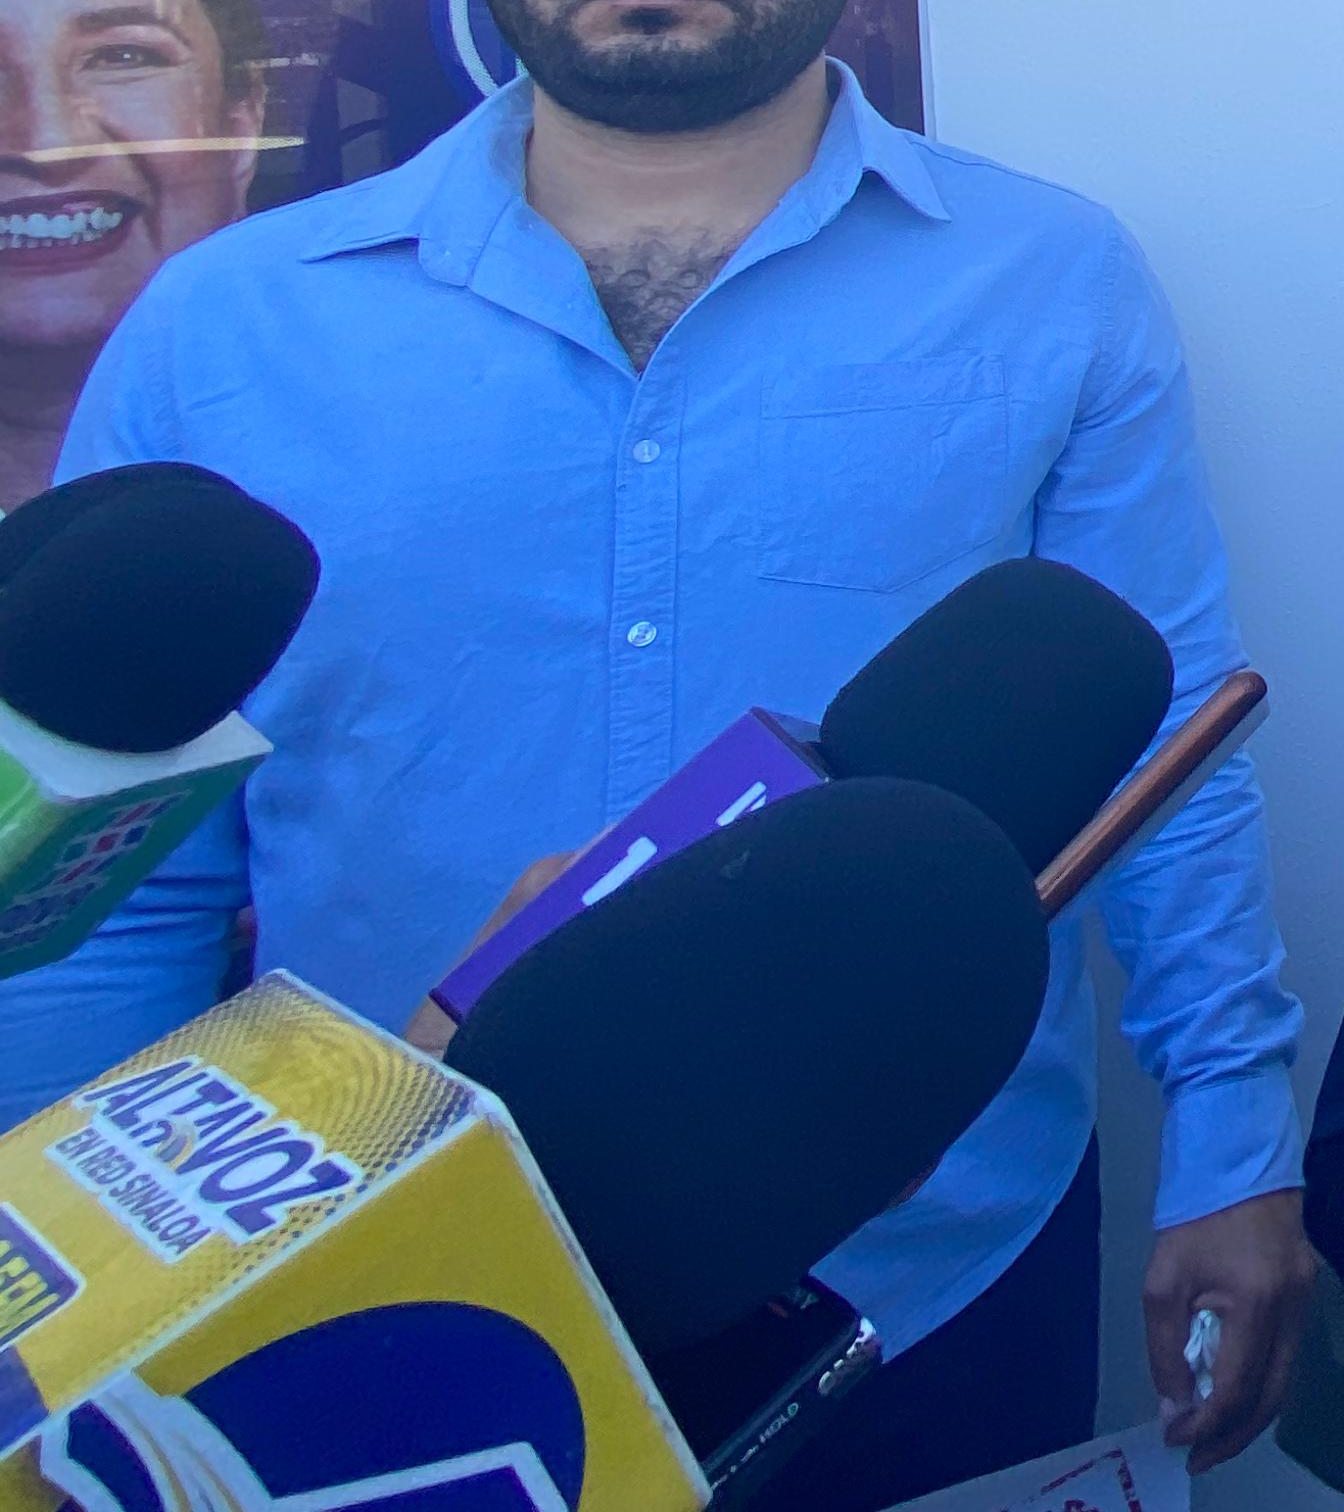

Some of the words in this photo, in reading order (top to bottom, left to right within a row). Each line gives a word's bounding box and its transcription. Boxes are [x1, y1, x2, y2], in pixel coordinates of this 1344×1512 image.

[55, 1127, 107, 1161] EN
[76, 1145, 137, 1185] RED
[82, 1061, 353, 1235] ALTAVOZ
[108, 1173, 211, 1255] SINALOA
